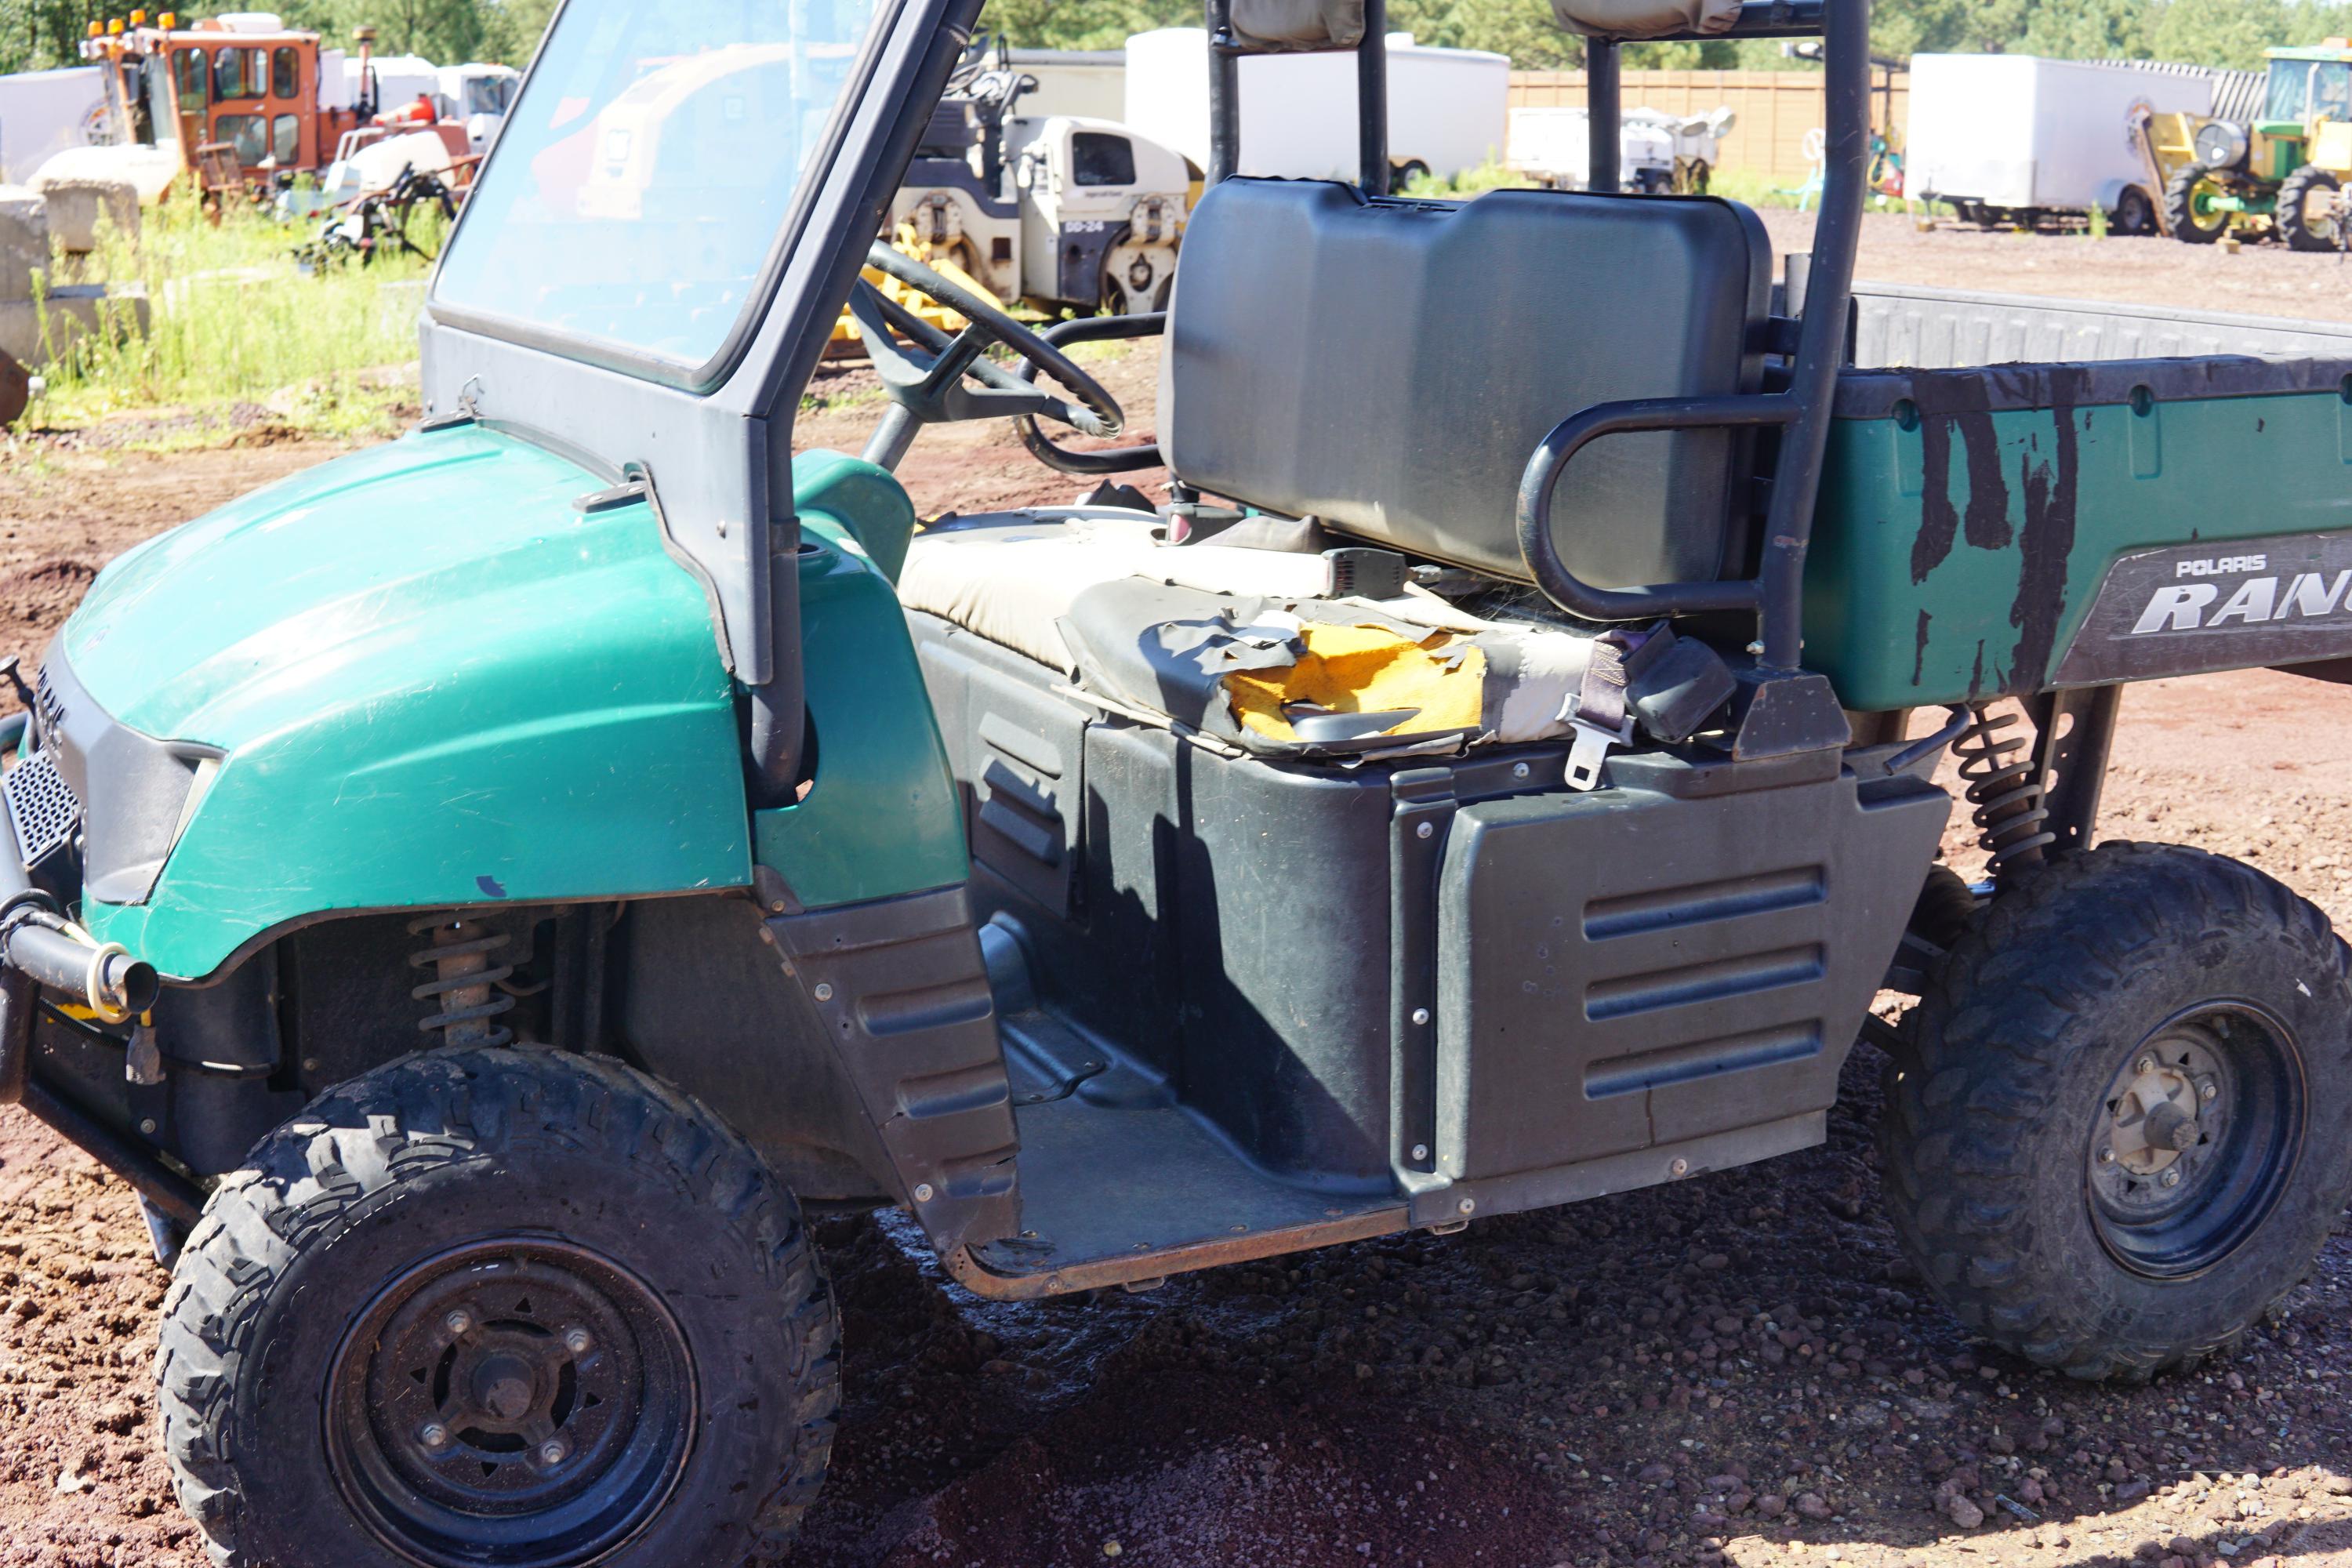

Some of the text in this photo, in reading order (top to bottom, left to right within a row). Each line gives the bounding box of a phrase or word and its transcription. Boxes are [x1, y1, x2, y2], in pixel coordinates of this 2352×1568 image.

[1065, 220, 1105, 233] DD-24
[2176, 554, 2267, 578] POLARIS
[2130, 569, 2352, 634] RAN
